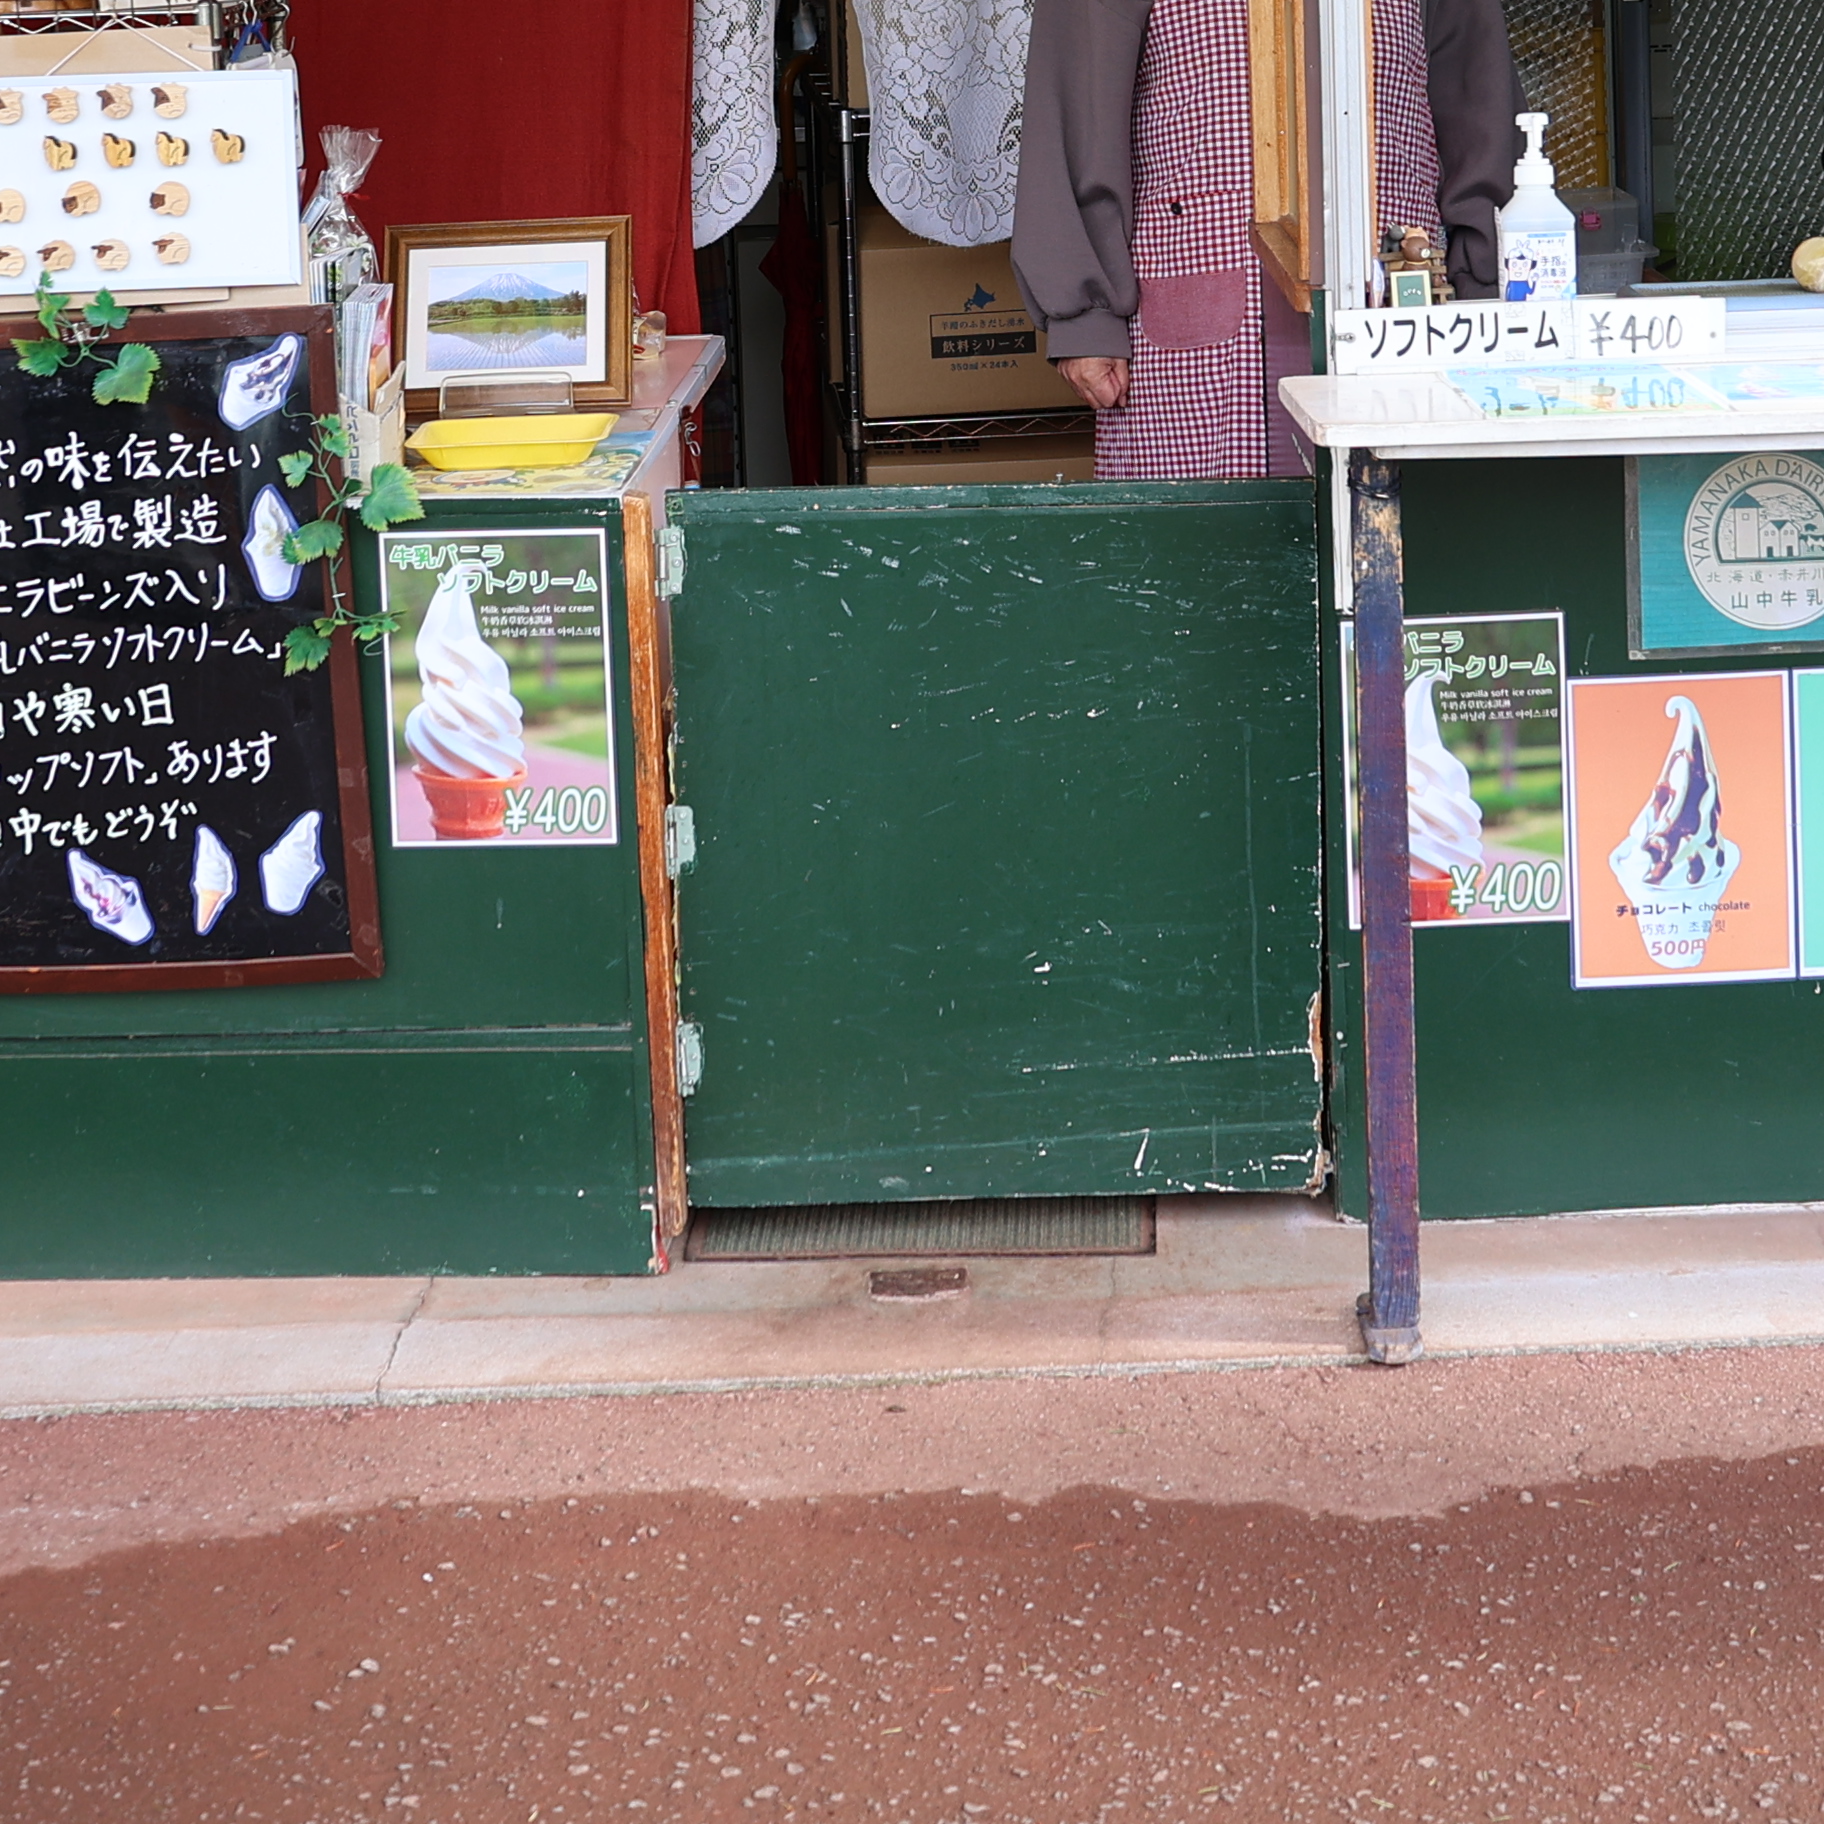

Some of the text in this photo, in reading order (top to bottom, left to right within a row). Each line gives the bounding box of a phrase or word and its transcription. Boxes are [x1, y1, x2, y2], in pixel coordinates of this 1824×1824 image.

[940, 334, 1026, 355] 飲料シリーズ
[1364, 310, 1560, 359] ソフトクリーム
[1690, 458, 1770, 567] YAMANAKA
[389, 542, 505, 571] 牛乳バニラ
[436, 569, 599, 596] ソフトクリーム
[480, 604, 595, 614] Milk vanilla soft ice cream
[1730, 588, 1824, 610] 山中牛乳
[1404, 652, 1557, 681] ソフトクリーム
[1439, 687, 1553, 700] Milk vanilla soft ice cream
[504, 785, 608, 837] ¥400
[1449, 861, 1562, 916] ¥400
[1616, 900, 1751, 918] チョコレート chocolate
[1650, 937, 1707, 956] 500円
